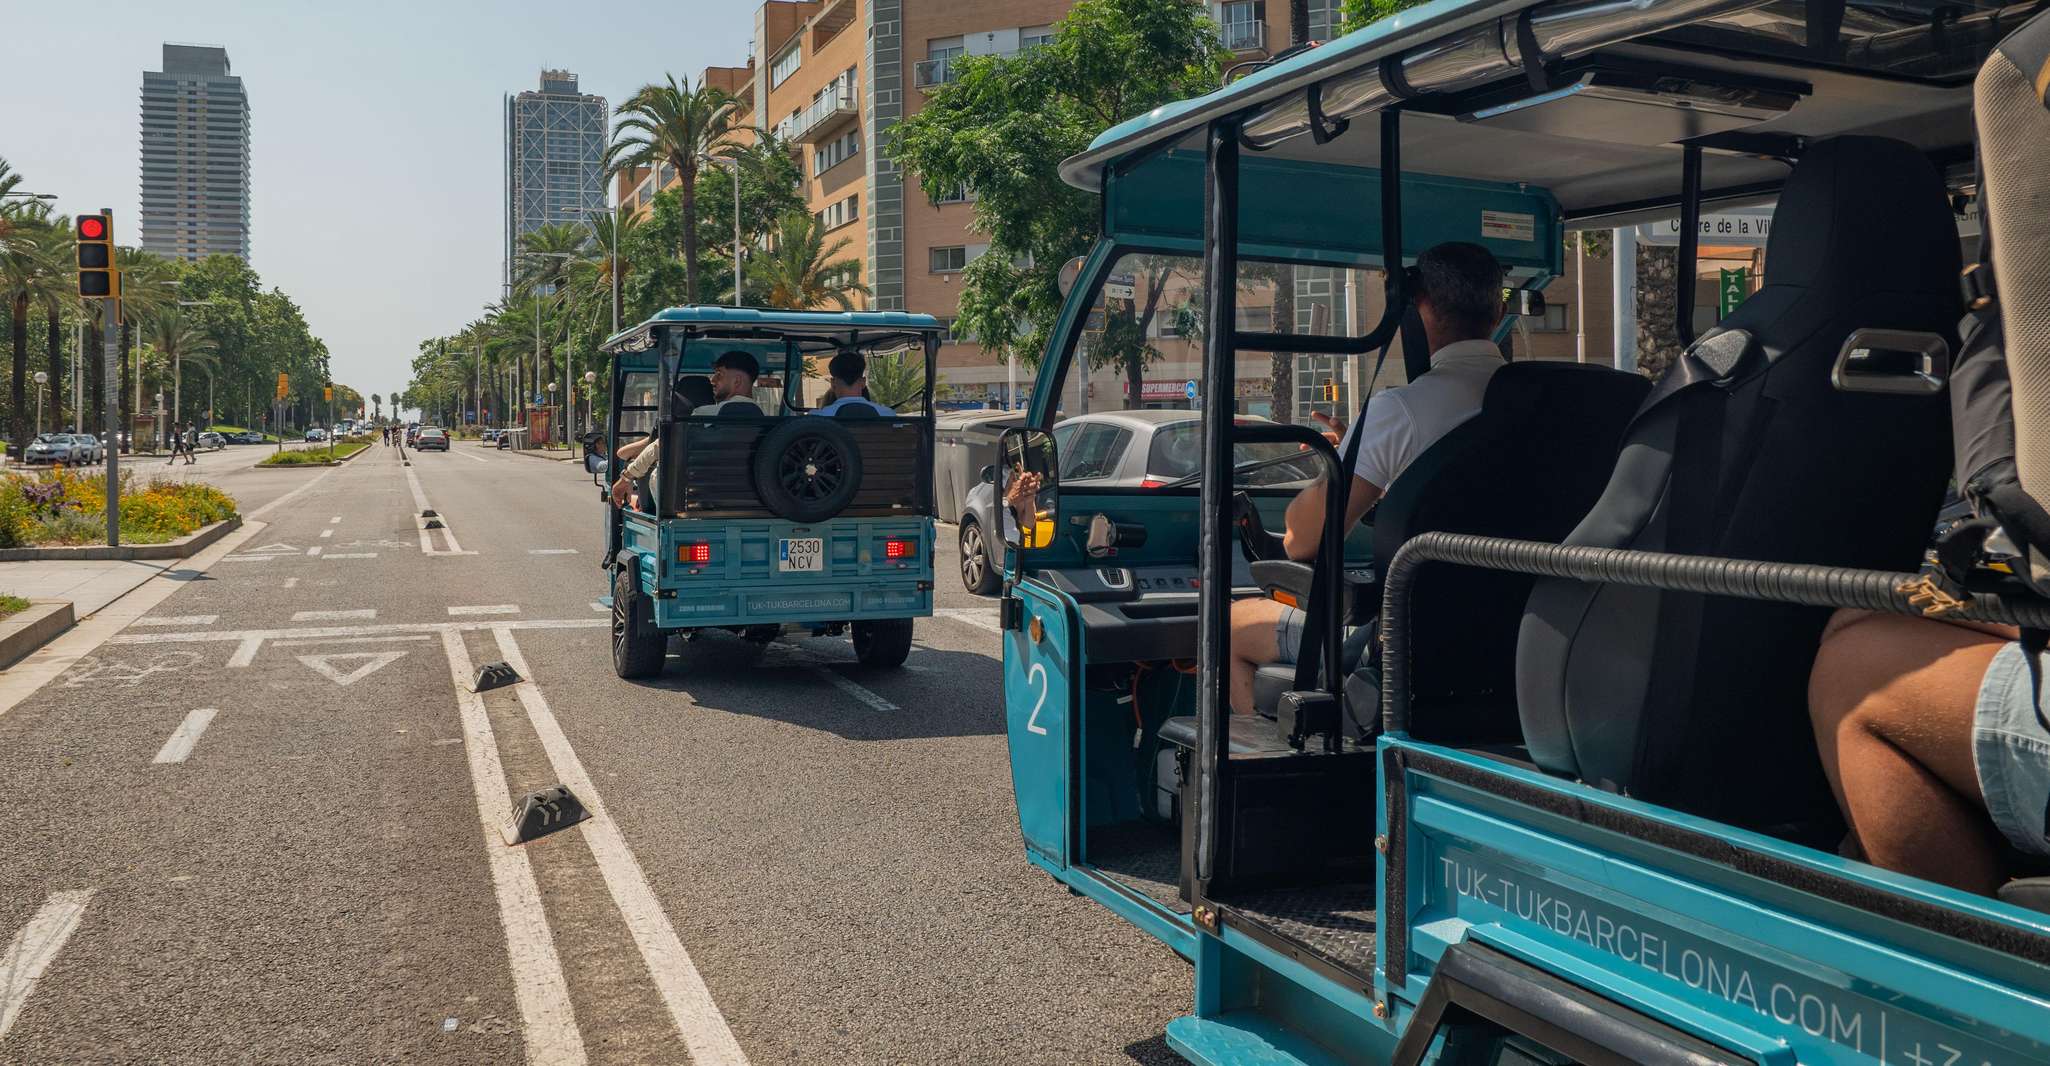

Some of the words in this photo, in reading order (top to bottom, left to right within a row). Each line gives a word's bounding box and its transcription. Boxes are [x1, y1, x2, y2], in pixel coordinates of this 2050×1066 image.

[1671, 219, 1711, 233] Cre
[1717, 218, 1732, 233] de
[1738, 218, 1749, 234] la
[1727, 274, 1740, 313] TALL
[1141, 382, 1186, 394] SUPERMERCA
[789, 540, 820, 554] 2530
[788, 555, 813, 569] NCV
[1026, 663, 1048, 736] 2
[1439, 856, 1862, 1053] TUK-TUKBARCELONA.COM
